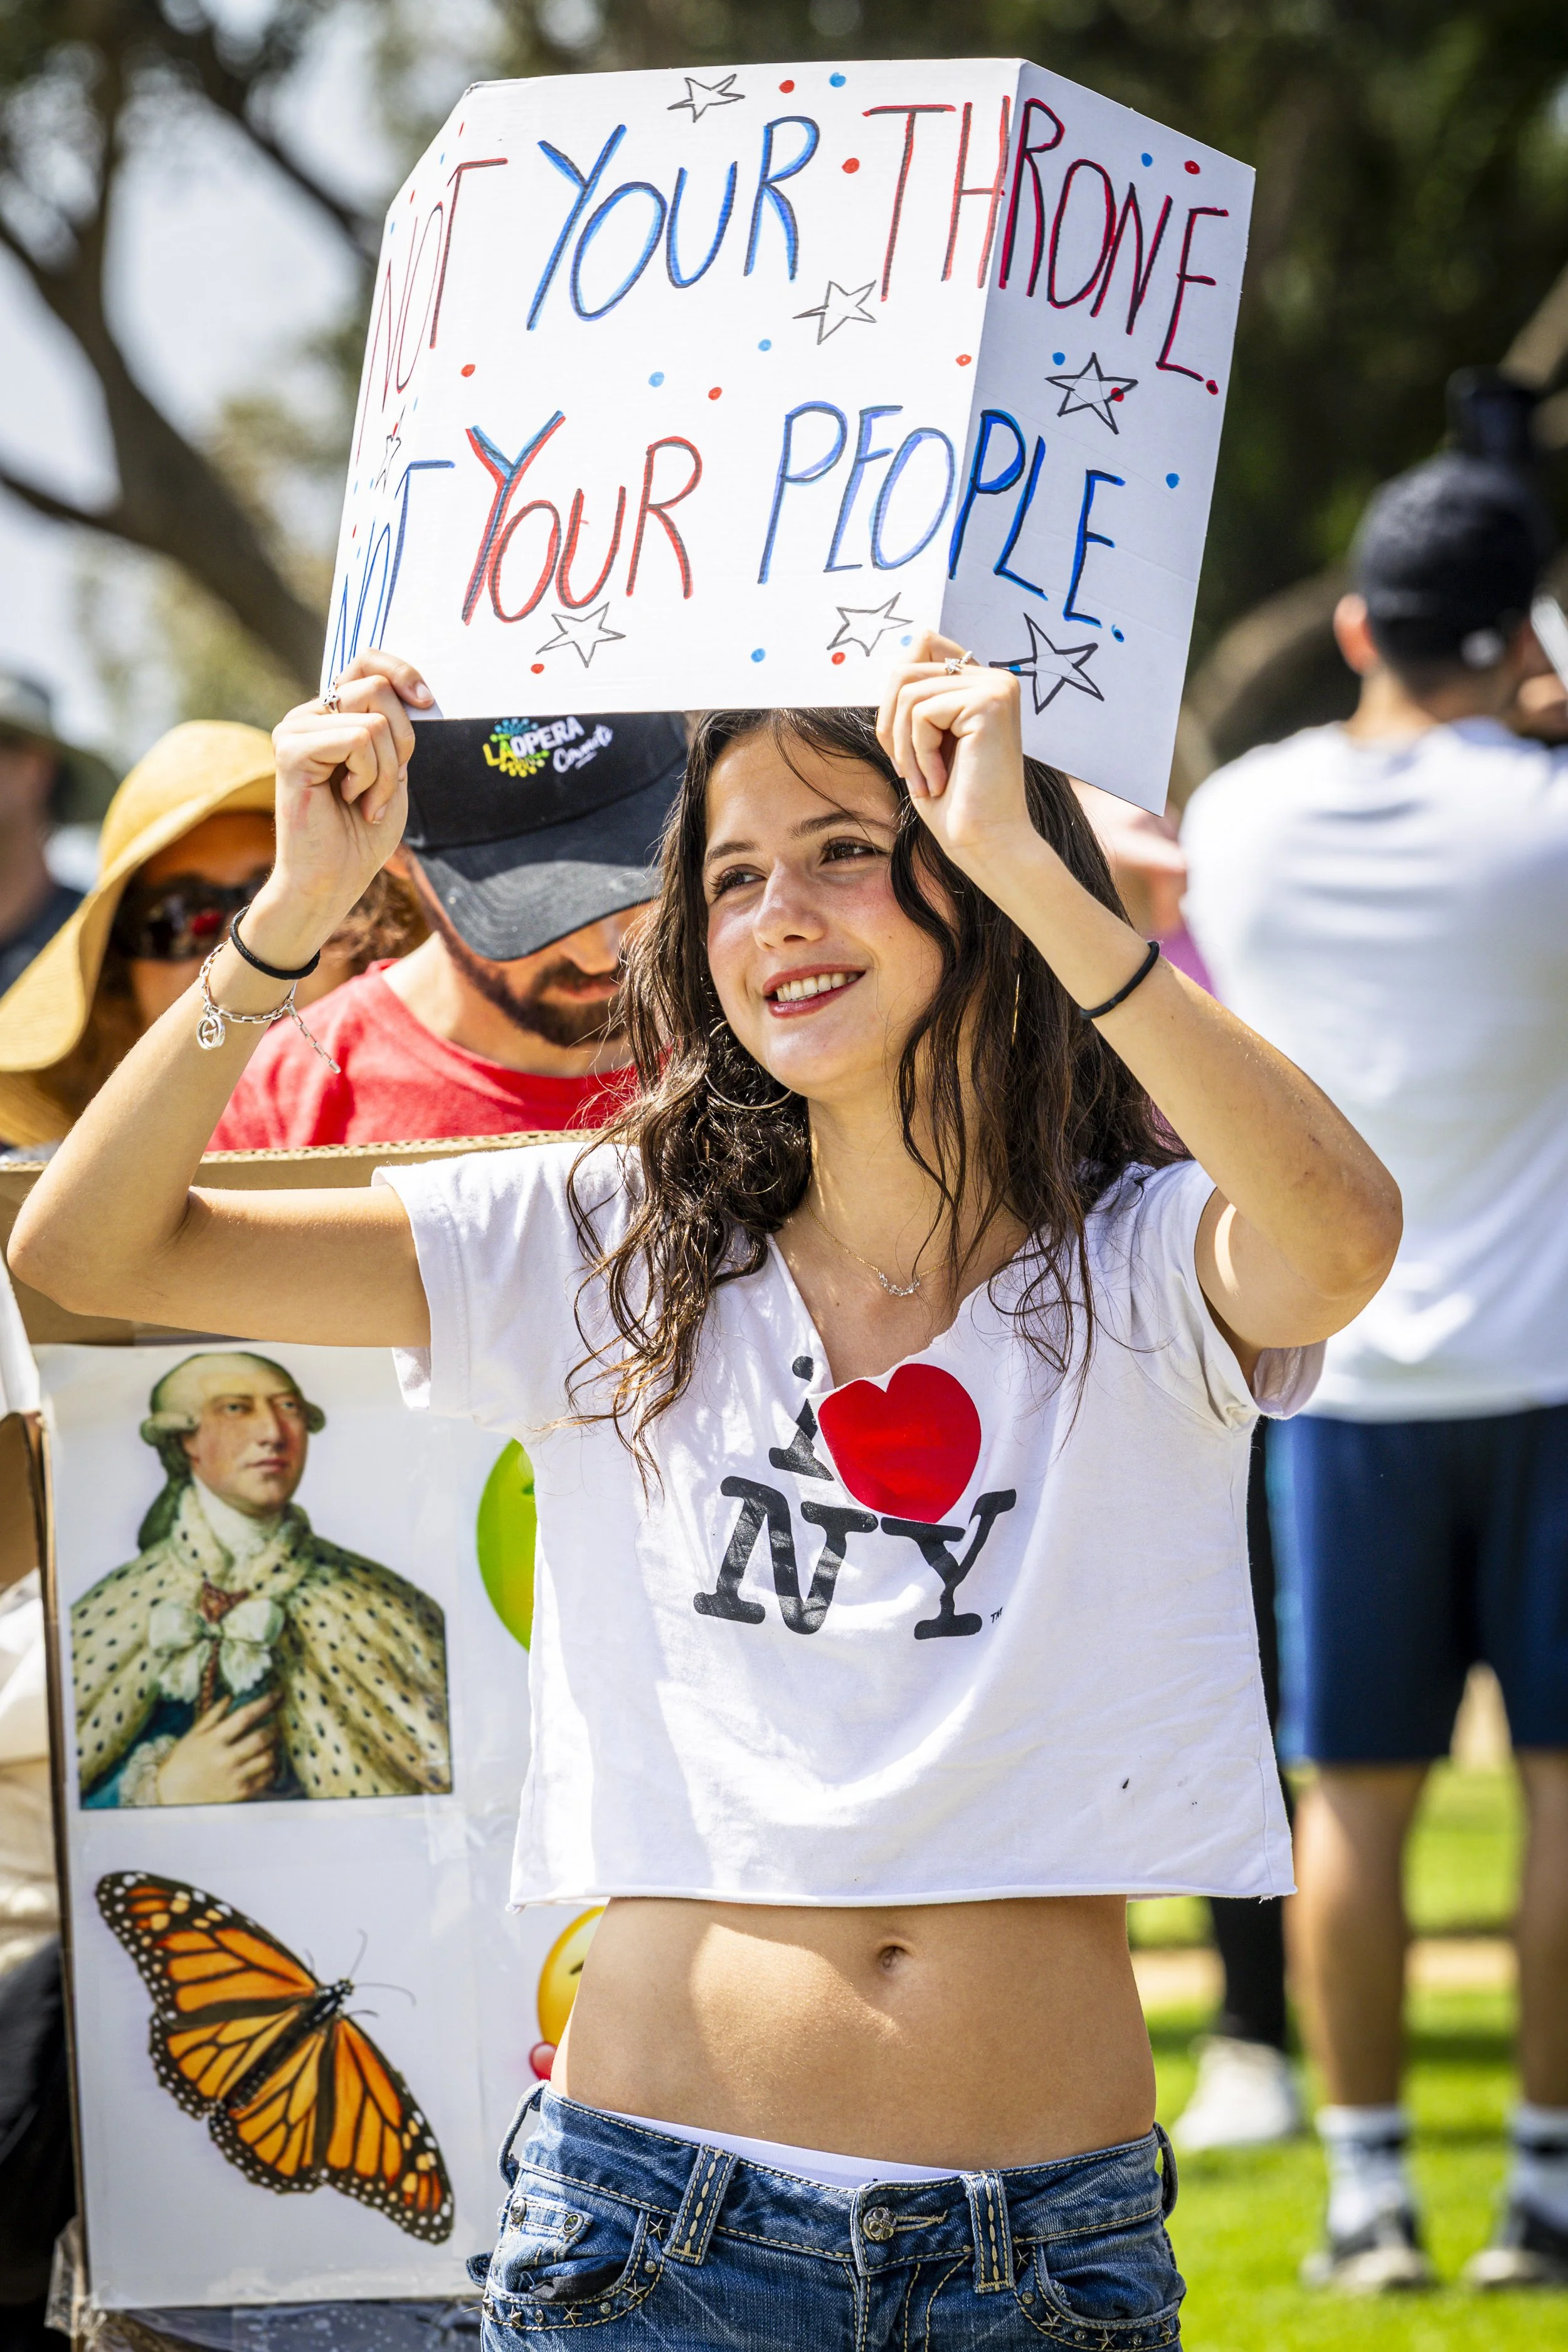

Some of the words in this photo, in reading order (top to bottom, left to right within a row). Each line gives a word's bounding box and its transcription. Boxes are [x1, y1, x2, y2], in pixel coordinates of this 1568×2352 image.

[356, 157, 509, 466] NOT
[526, 115, 820, 331] YOUR
[328, 460, 455, 689] NOT
[462, 410, 702, 625] YOUR
[510, 716, 585, 758] OPERA
[694, 1476, 1017, 1640] NY
